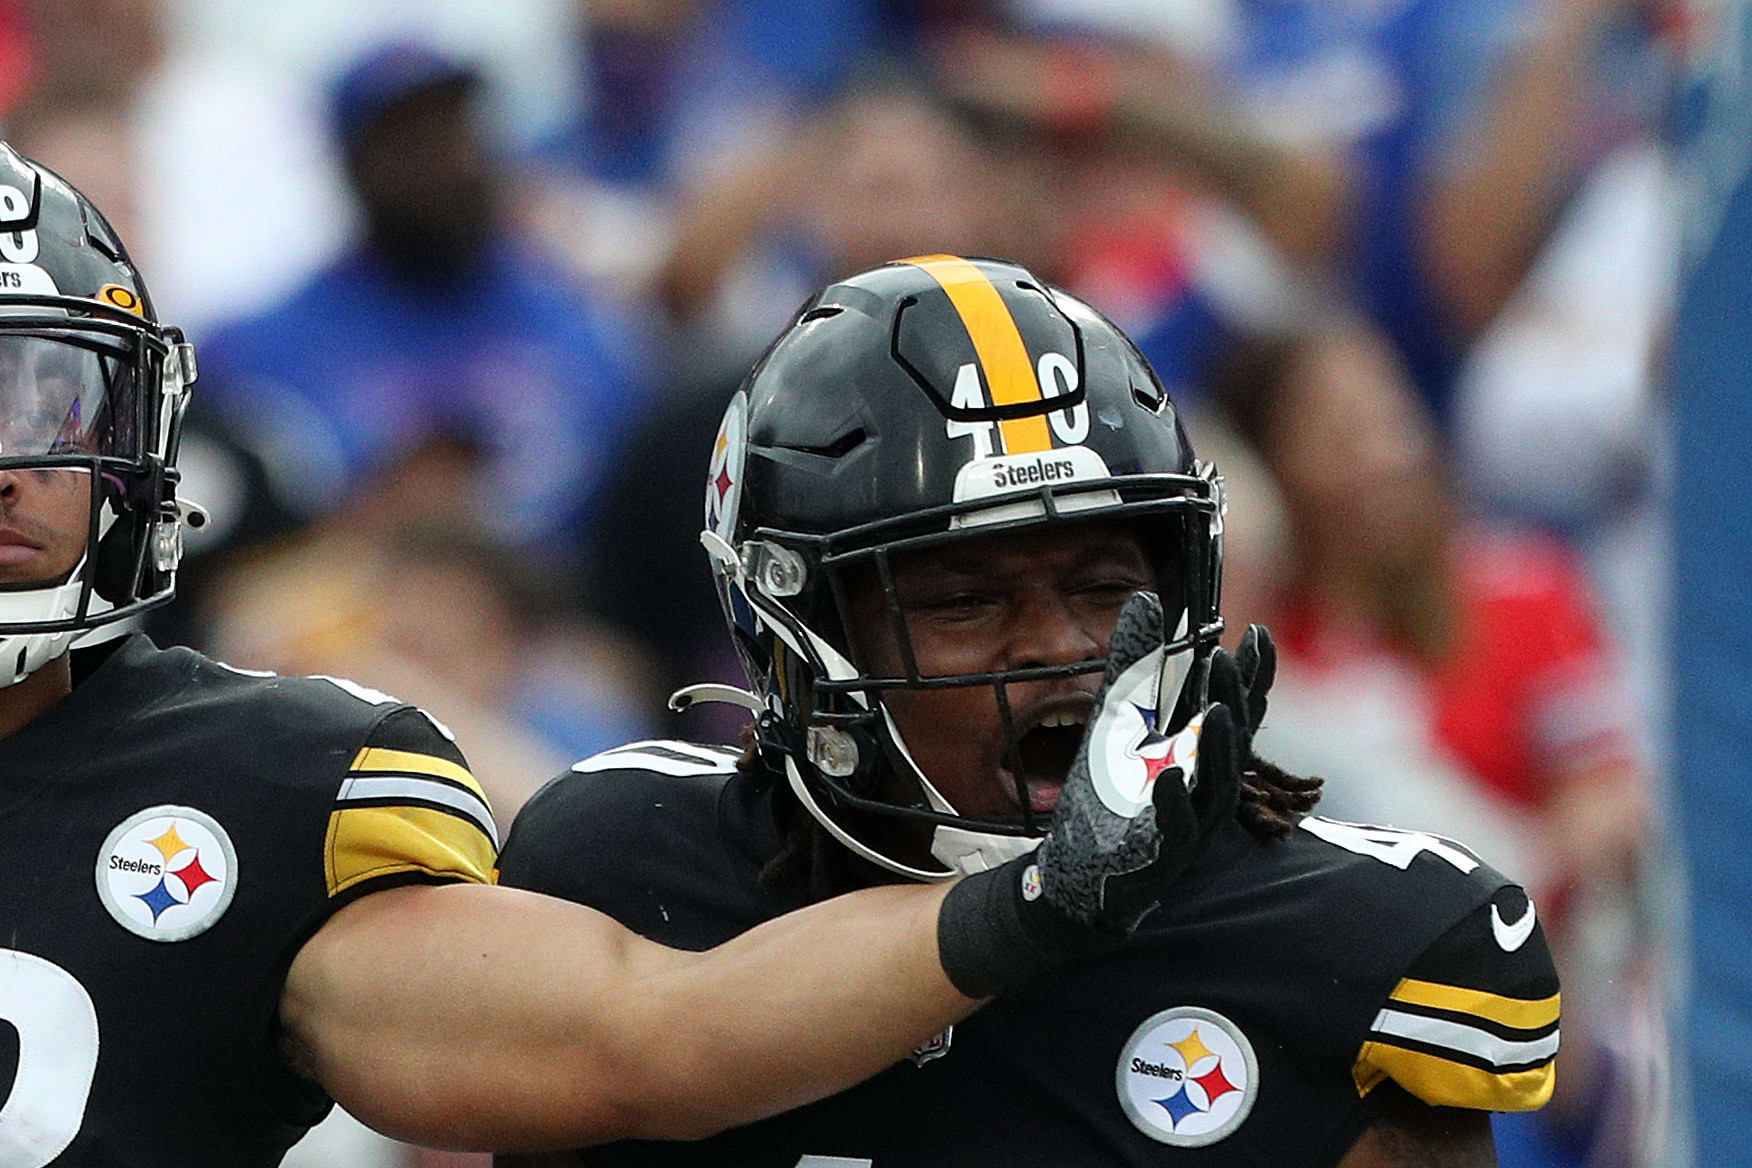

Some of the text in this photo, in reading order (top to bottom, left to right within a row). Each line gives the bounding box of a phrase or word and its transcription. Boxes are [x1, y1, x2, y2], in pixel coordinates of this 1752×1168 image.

[946, 352, 1090, 463] 40
[992, 458, 1075, 489] Steelers
[109, 854, 162, 876] Steelers
[1130, 1057, 1184, 1082] Steelers
